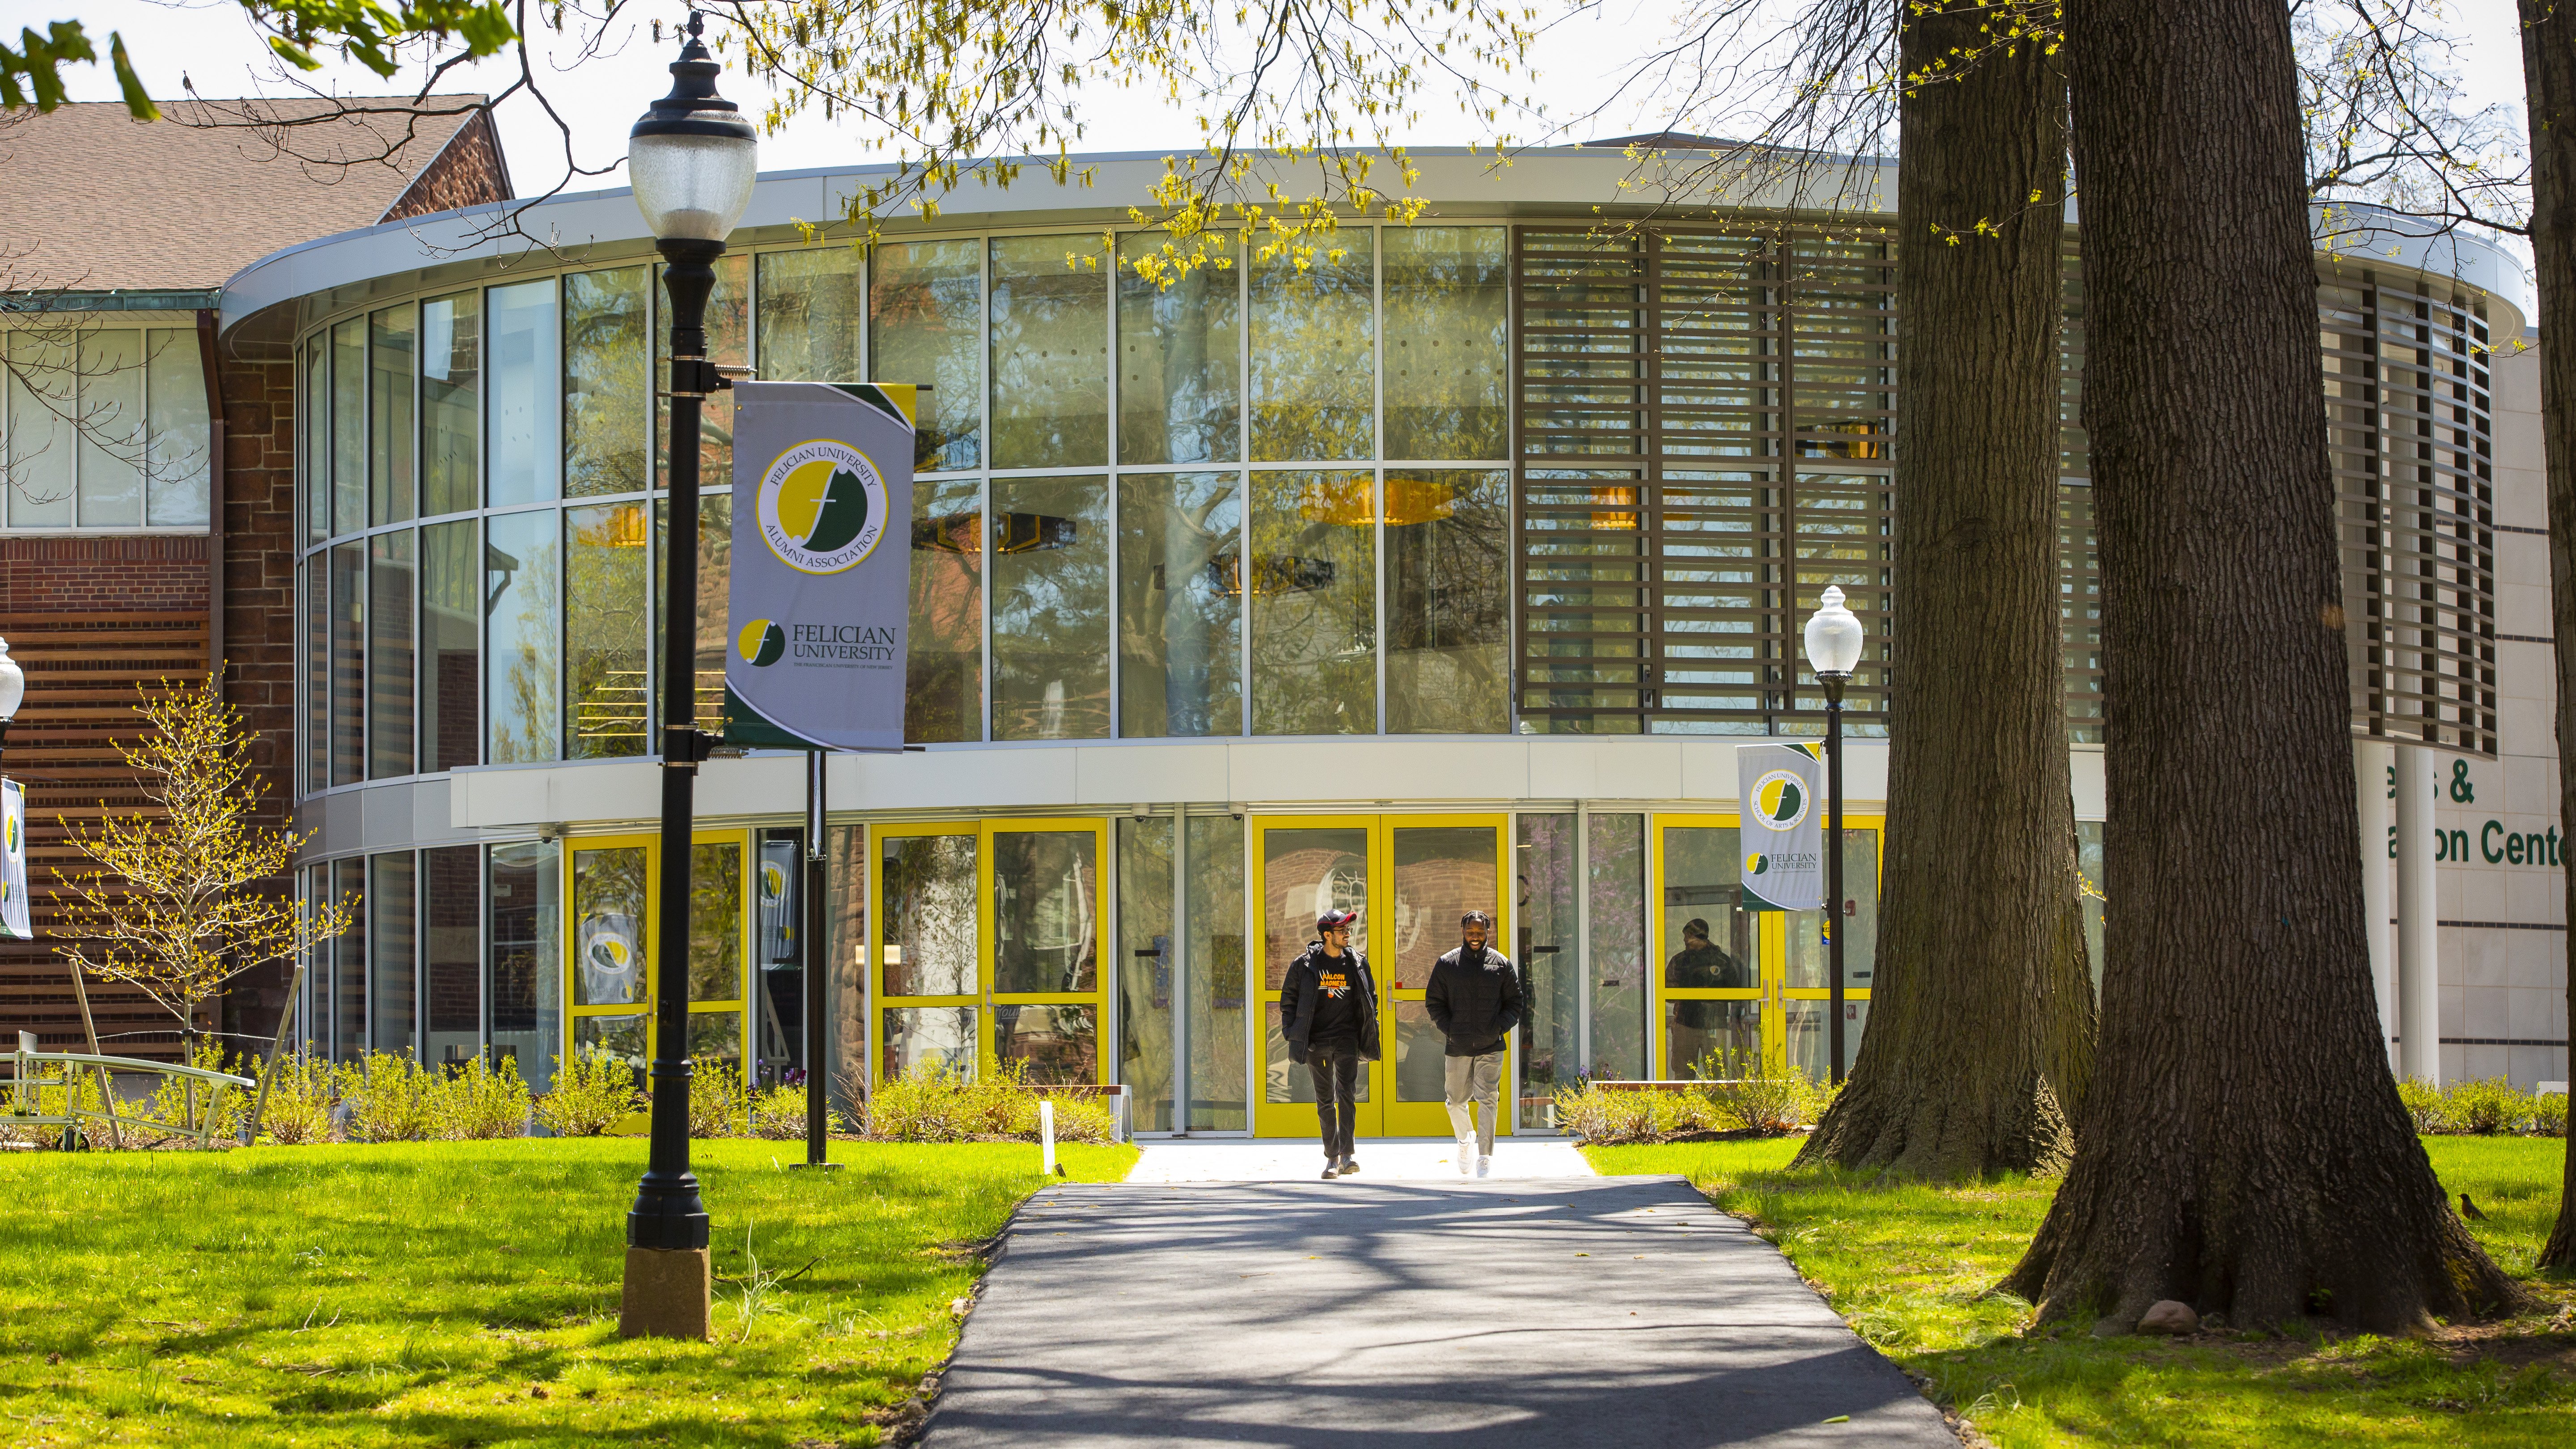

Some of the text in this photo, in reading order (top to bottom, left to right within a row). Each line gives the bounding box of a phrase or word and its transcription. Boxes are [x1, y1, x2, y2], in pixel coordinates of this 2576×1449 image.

[770, 447, 877, 487] FELICIAN UNIVERSITY
[766, 525, 877, 568] ALUMNI ASSOCIATION
[792, 624, 896, 644] FELICIAN
[793, 644, 895, 660] UNIVERSITY
[1756, 773, 1804, 792] FELICIAN UNIVERSITY
[2450, 759, 2475, 804] &
[1754, 800, 1765, 822] SCHOOL
[1793, 798, 1807, 823] SCIENCES
[1771, 853, 1817, 862] FELICIAN
